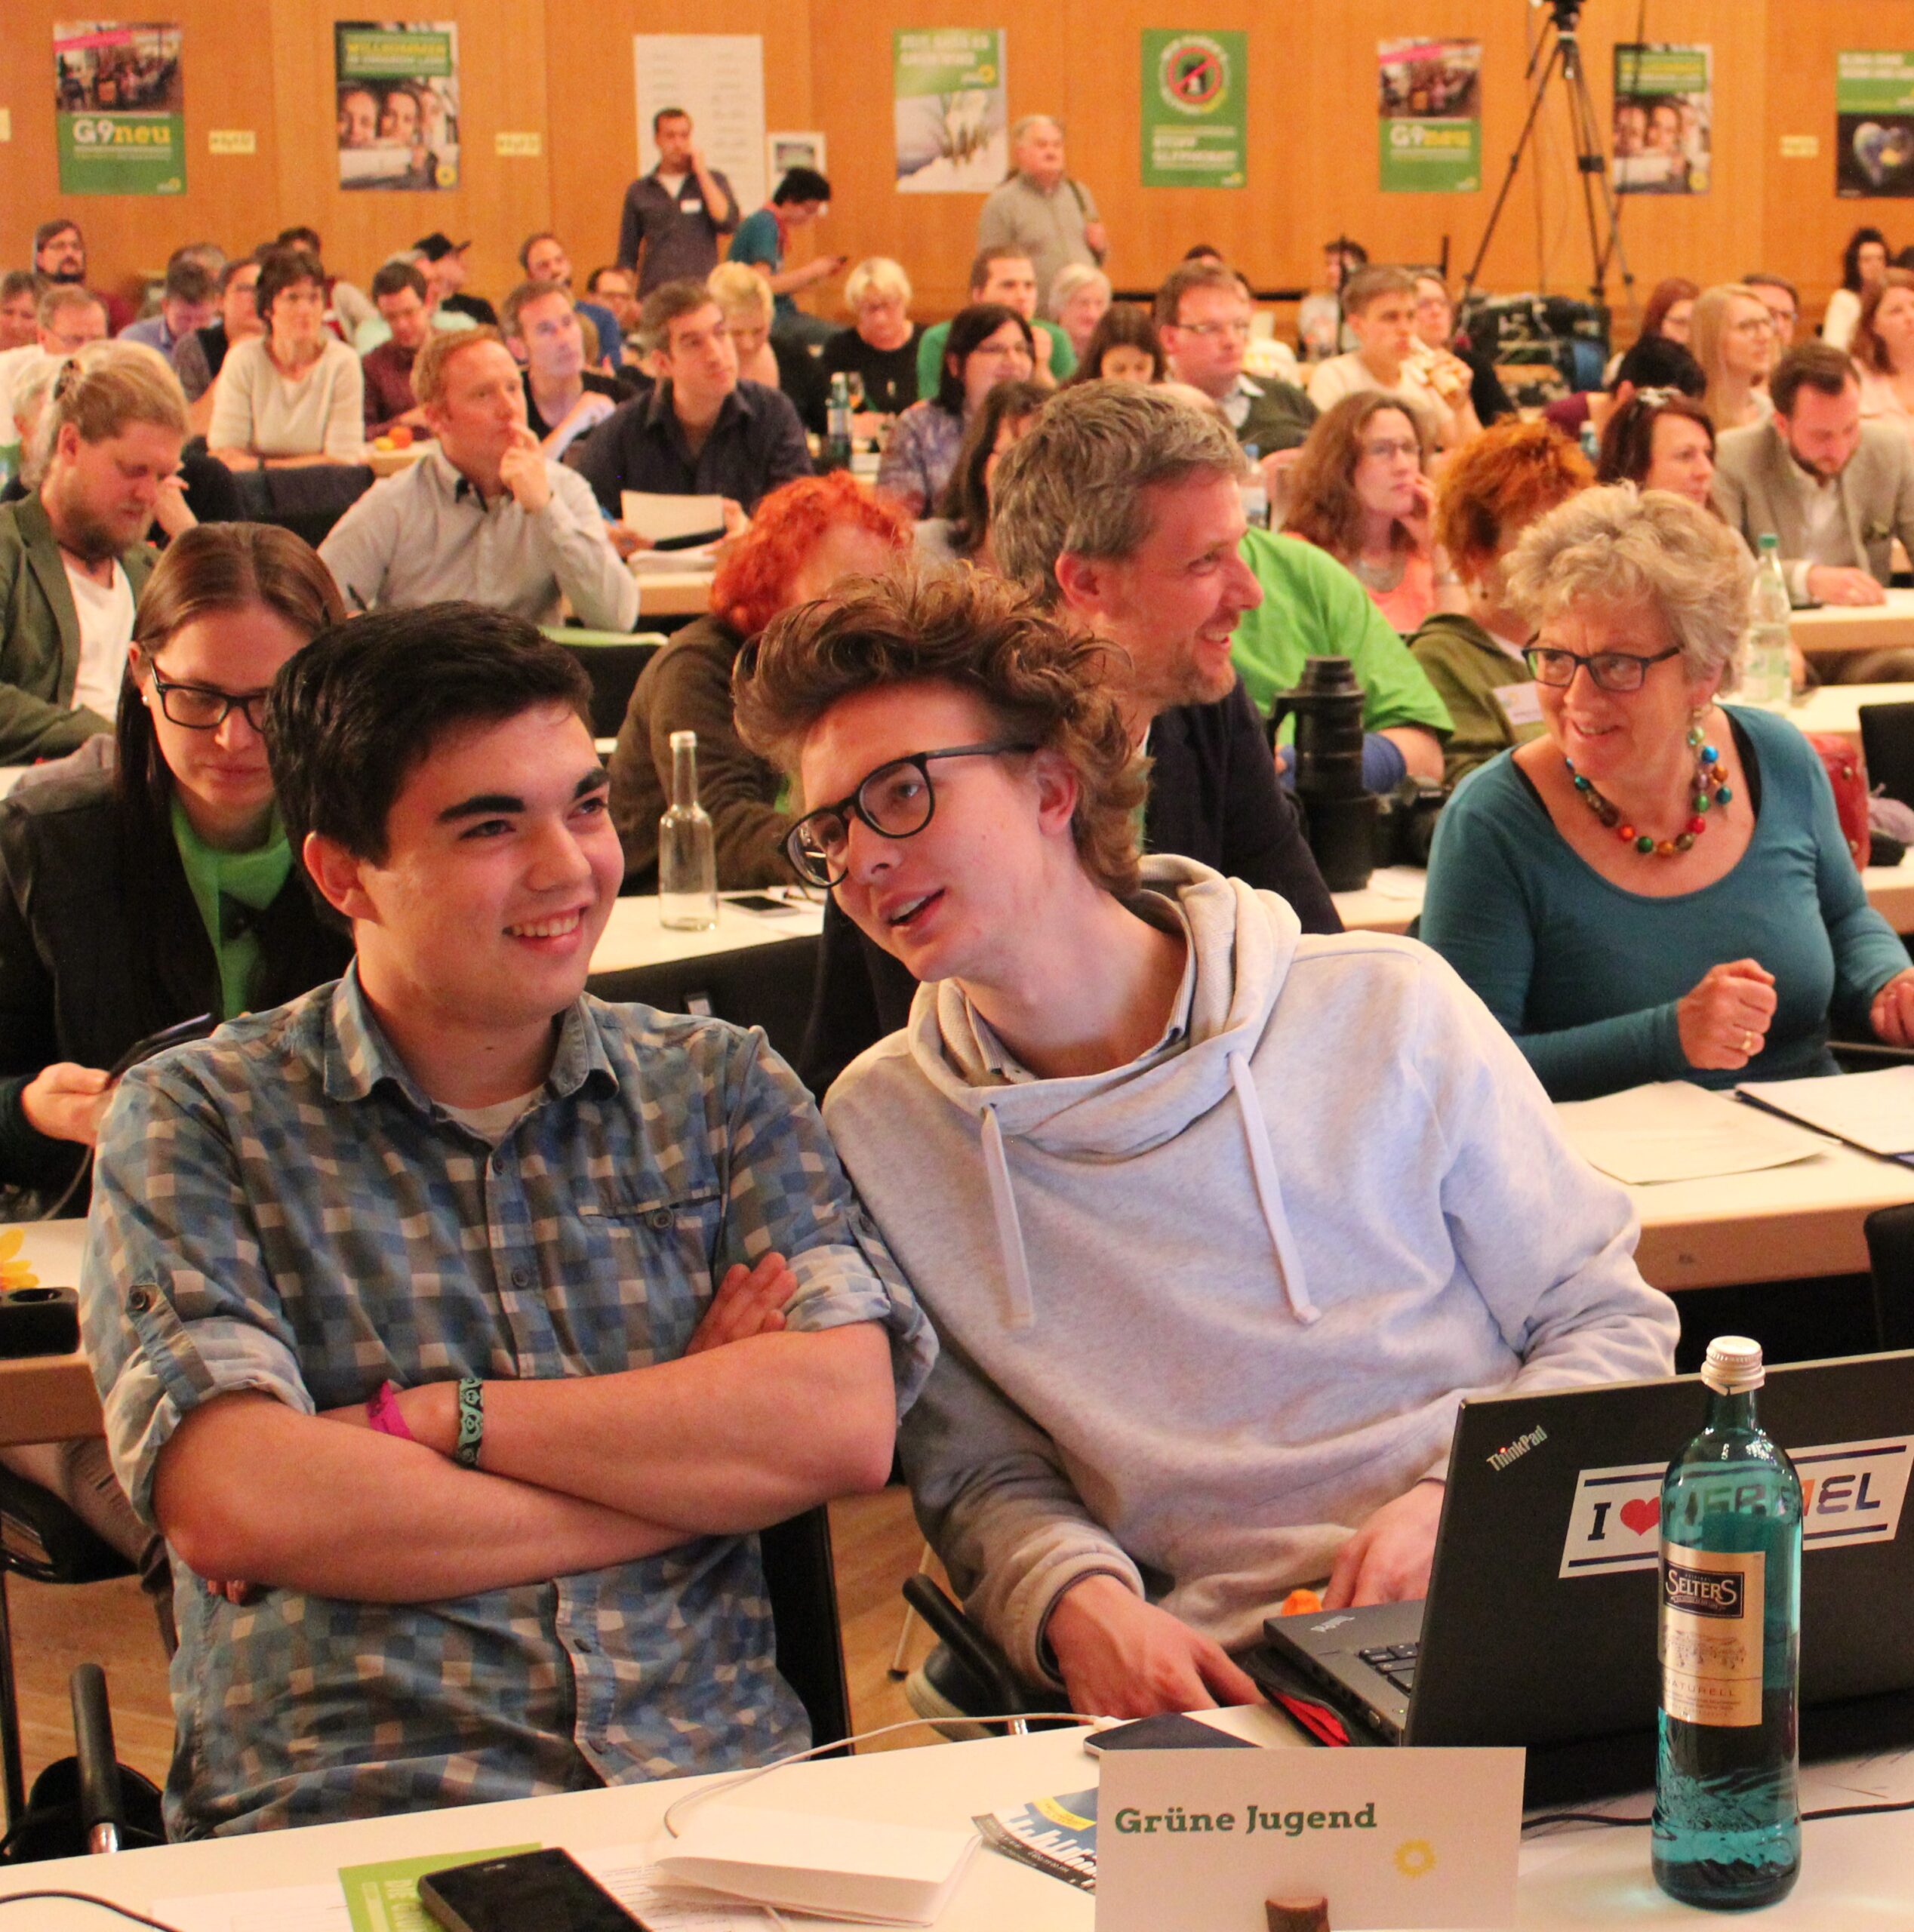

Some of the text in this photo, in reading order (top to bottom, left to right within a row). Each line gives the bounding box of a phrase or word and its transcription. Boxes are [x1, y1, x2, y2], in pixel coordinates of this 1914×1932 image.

[72, 118, 171, 144] G9neu
[1486, 1424, 1548, 1471] ThinkPad
[1587, 1502, 1611, 1542] I
[1114, 1807, 1235, 1834] Grüne
[1245, 1802, 1377, 1837] Jugend
